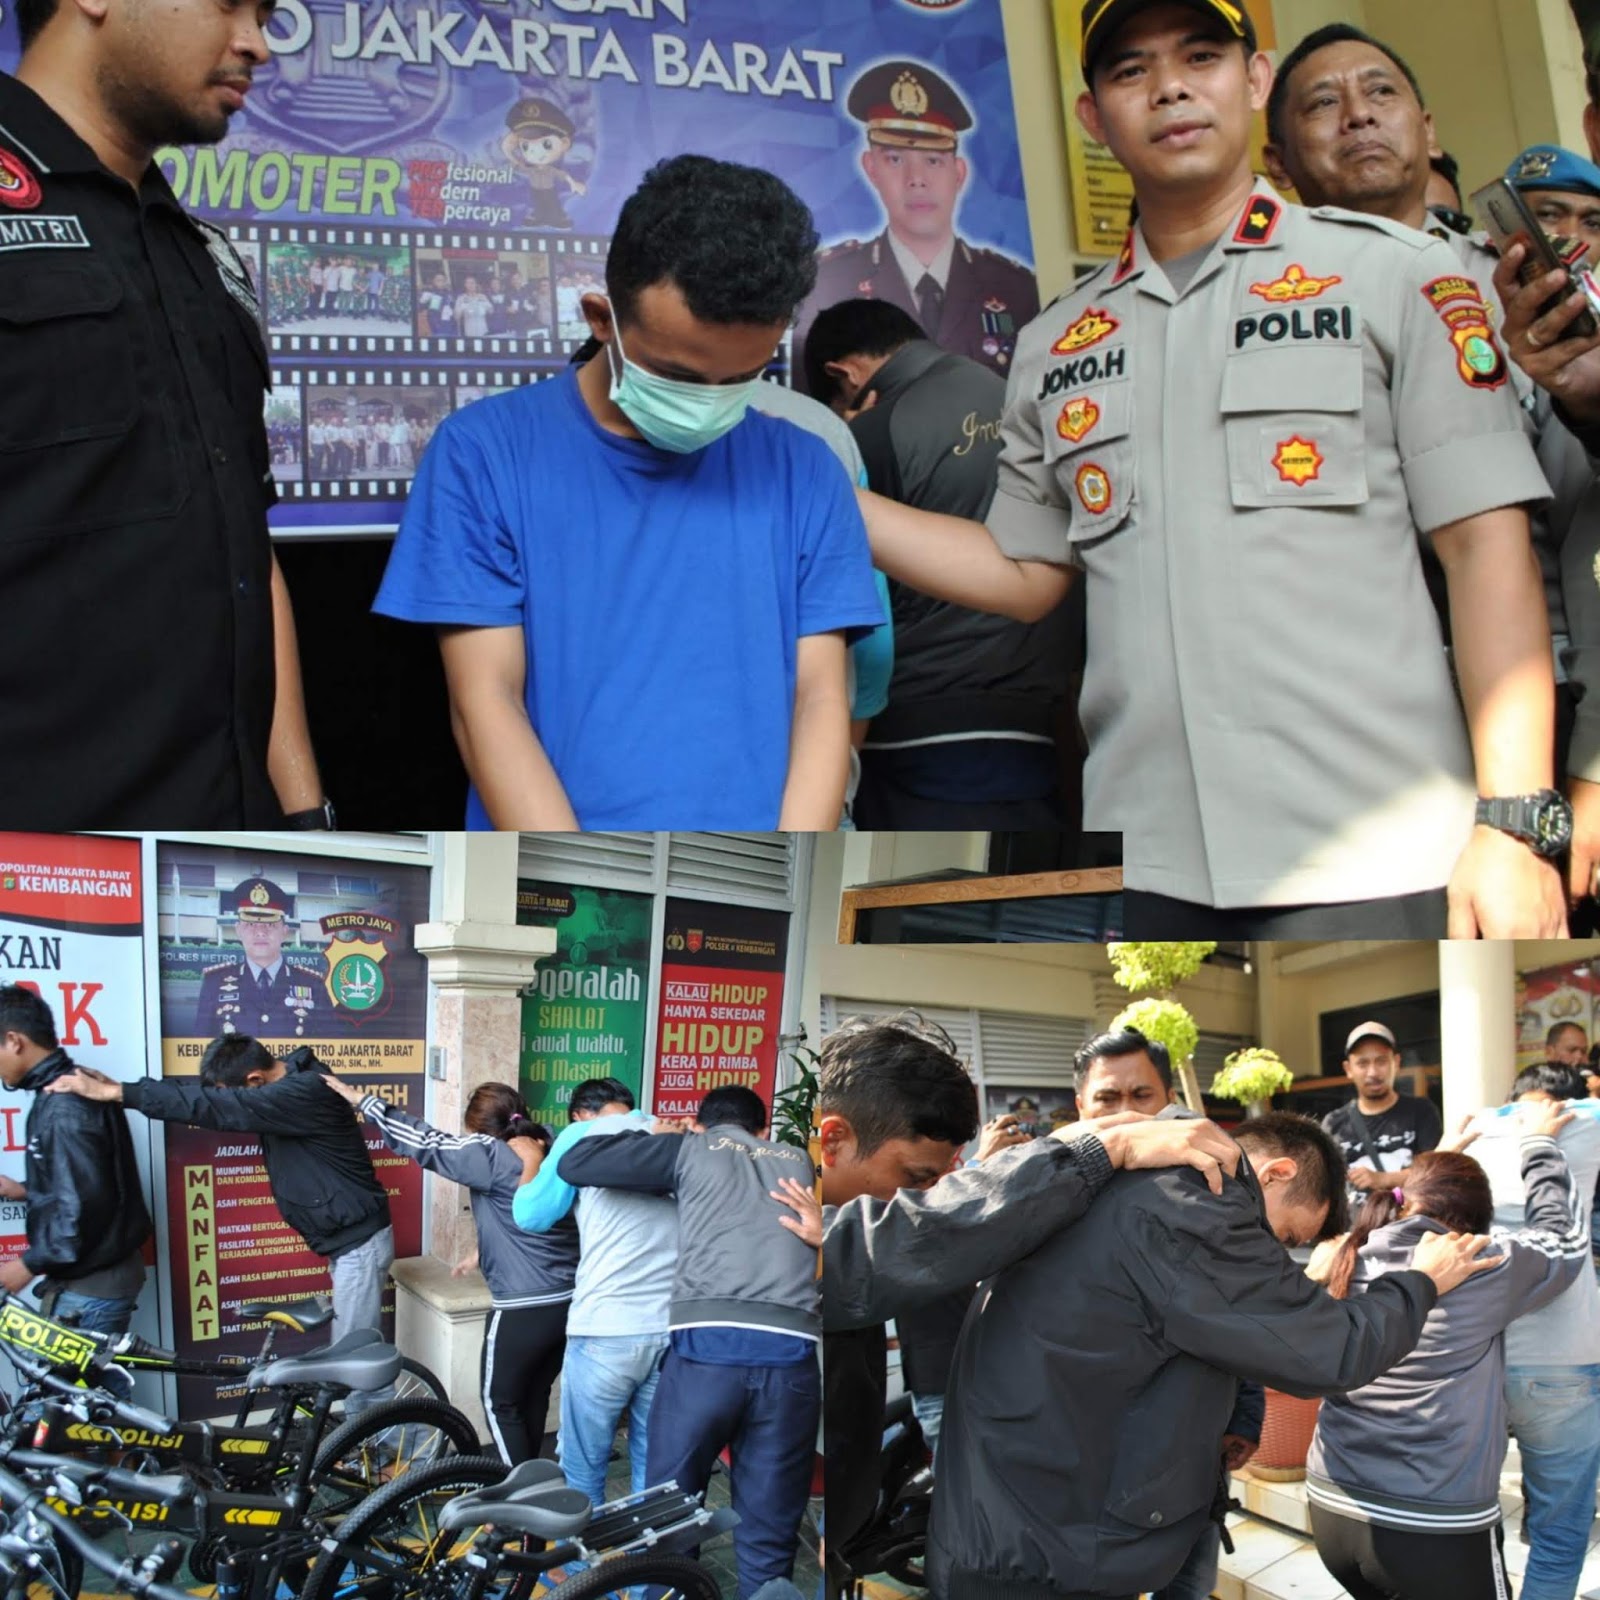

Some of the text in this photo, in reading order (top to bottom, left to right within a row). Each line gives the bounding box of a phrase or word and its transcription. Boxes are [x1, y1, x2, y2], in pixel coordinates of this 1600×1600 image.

[332, 0, 639, 82] JAKARTA
[651, 32, 844, 101] BARAT
[1235, 305, 1352, 350] POLRI
[1038, 348, 1126, 401] JOKO.H
[52, 866, 98, 879] JAKARTA
[99, 869, 132, 881] BARAT
[18, 875, 133, 898] KEMBANGAN
[326, 915, 393, 932] METRO JAYA
[160, 952, 199, 962] POLRES
[201, 954, 237, 965] METRO
[286, 956, 319, 966] BARAT
[666, 983, 768, 1005] KALAU HIDUP
[539, 1005, 607, 1030] SHALAT
[664, 1004, 766, 1022] HANYA SEKEDAR
[531, 1033, 571, 1054] awal
[576, 1033, 629, 1056] waktu,
[662, 1023, 764, 1055] HIDUP
[337, 1045, 381, 1058] JAKARTA
[384, 1045, 414, 1058] BARAT
[661, 1055, 759, 1070] KERA DI RIMBA
[530, 1060, 546, 1082] di
[660, 1074, 695, 1087] JUGA
[215, 1144, 259, 1157] JADILAH
[215, 1165, 254, 1176] MUMPUNI
[217, 1175, 234, 1185] DAN
[216, 1199, 237, 1208] ASAH
[218, 1223, 251, 1235] NIATKAN
[218, 1238, 255, 1250] FASILITAS
[188, 1168, 214, 1337] MANFAAT
[219, 1247, 263, 1260] KERJASAMA
[263, 1245, 294, 1256] DENGAN
[219, 1274, 241, 1286] ASAH
[241, 1273, 261, 1283] RASA
[261, 1269, 289, 1280] EMPATI
[289, 1265, 327, 1278] TERHADAP
[222, 1324, 241, 1334] TAAT
[241, 1321, 262, 1332] PADA
